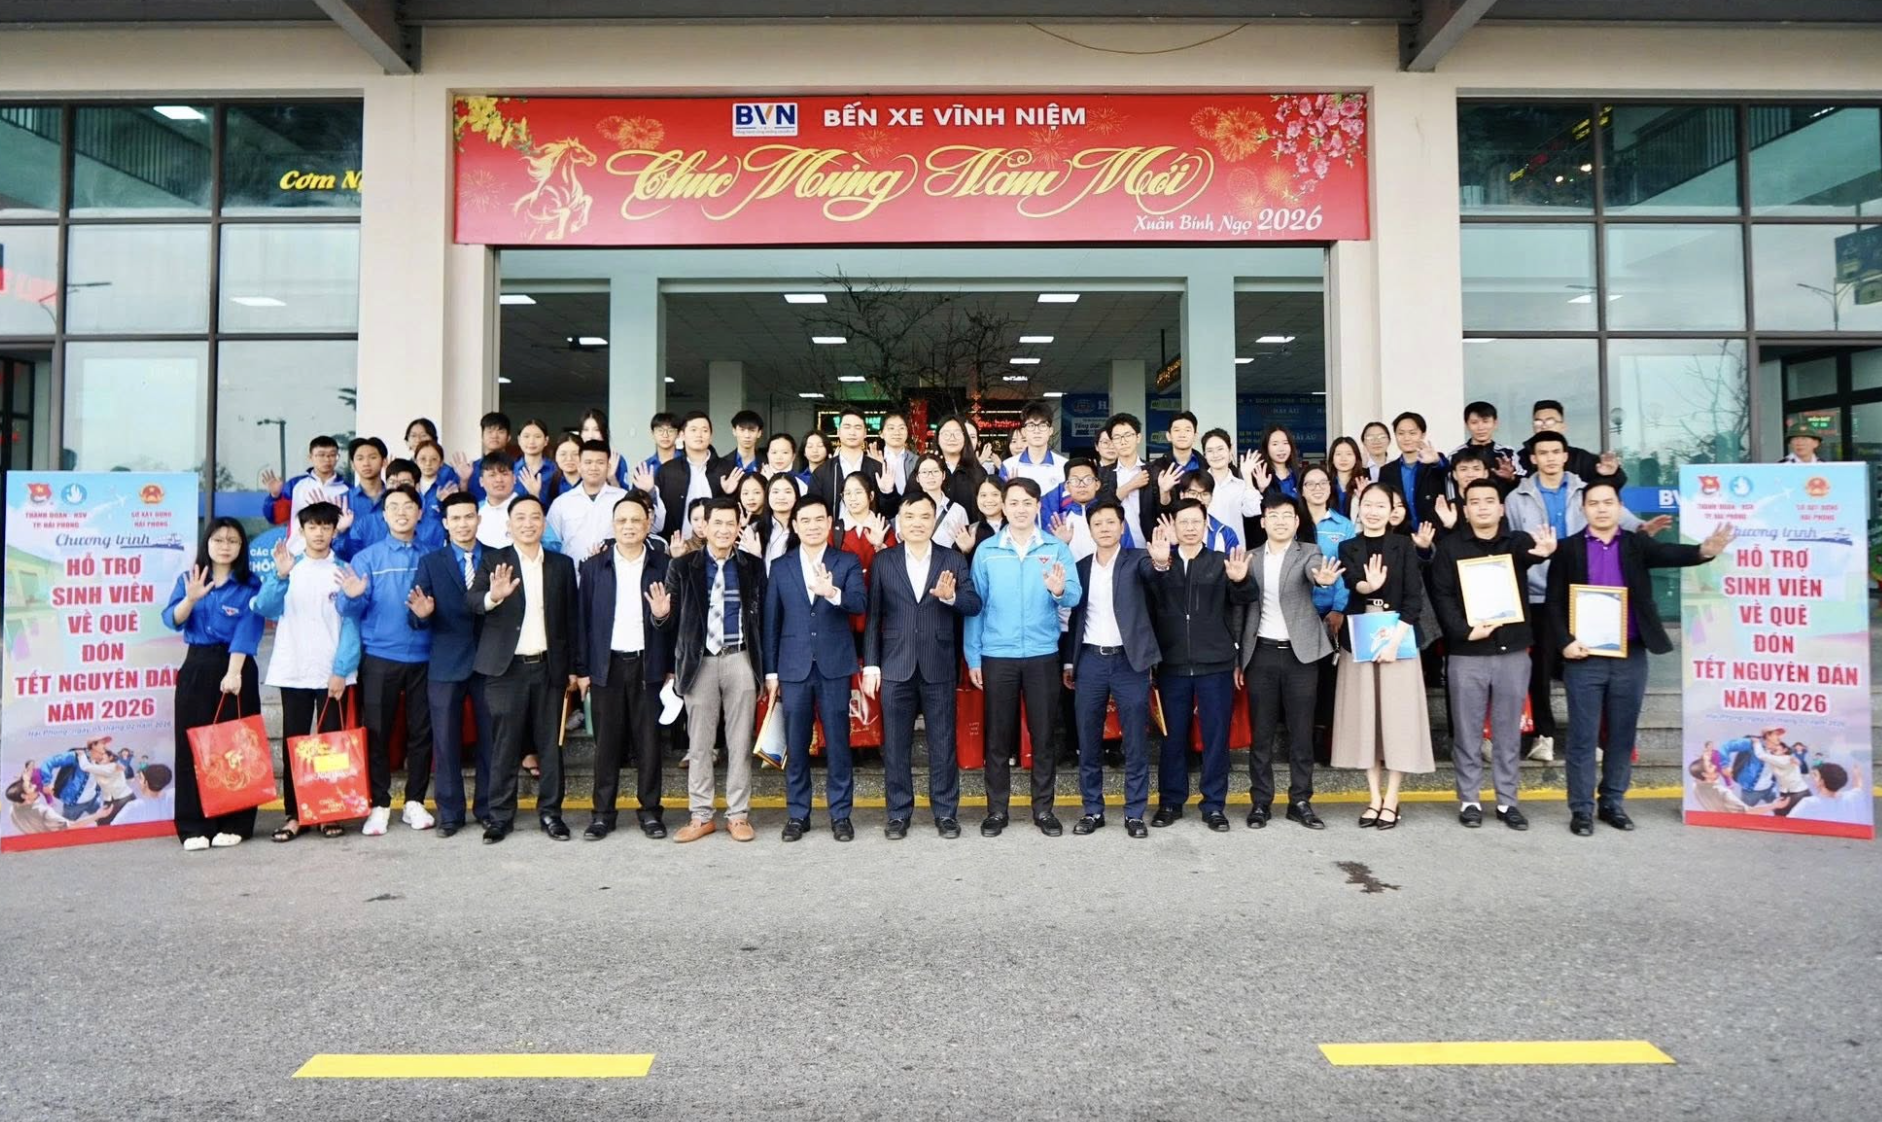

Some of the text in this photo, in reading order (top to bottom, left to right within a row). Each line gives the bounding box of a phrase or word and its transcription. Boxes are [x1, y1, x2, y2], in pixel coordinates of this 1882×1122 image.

[736, 105, 795, 125] BVN
[824, 101, 1086, 130] BẾN XE VĨNH NIỆM
[279, 170, 363, 193] Cơm N
[605, 143, 1215, 222] Chúc Mừng Năm Mới
[1134, 205, 1323, 235] Xuân Bính Ngọ 2026
[55, 532, 111, 549] Chương
[1733, 525, 1779, 541] hương
[250, 547, 269, 557] CÁC
[1736, 544, 1809, 572] HỖ TRỢ
[67, 553, 142, 578] HỖ TRỢ
[52, 582, 154, 606] SINH VIÊN
[1724, 575, 1822, 597] SINH VIÊN
[68, 609, 138, 634] VỀ QUÊ
[1739, 600, 1808, 627] VỀ QUÊ
[82, 641, 124, 662] ĐÓN
[1754, 632, 1794, 654] ĐÓN
[15, 669, 51, 695] TẾT
[59, 668, 138, 693] NGUYÊN
[1693, 654, 1858, 686] TẾT NGUYÊN ĐÁN
[47, 698, 155, 722] NĂM 2026
[1724, 688, 1827, 713] NĂM 2026
